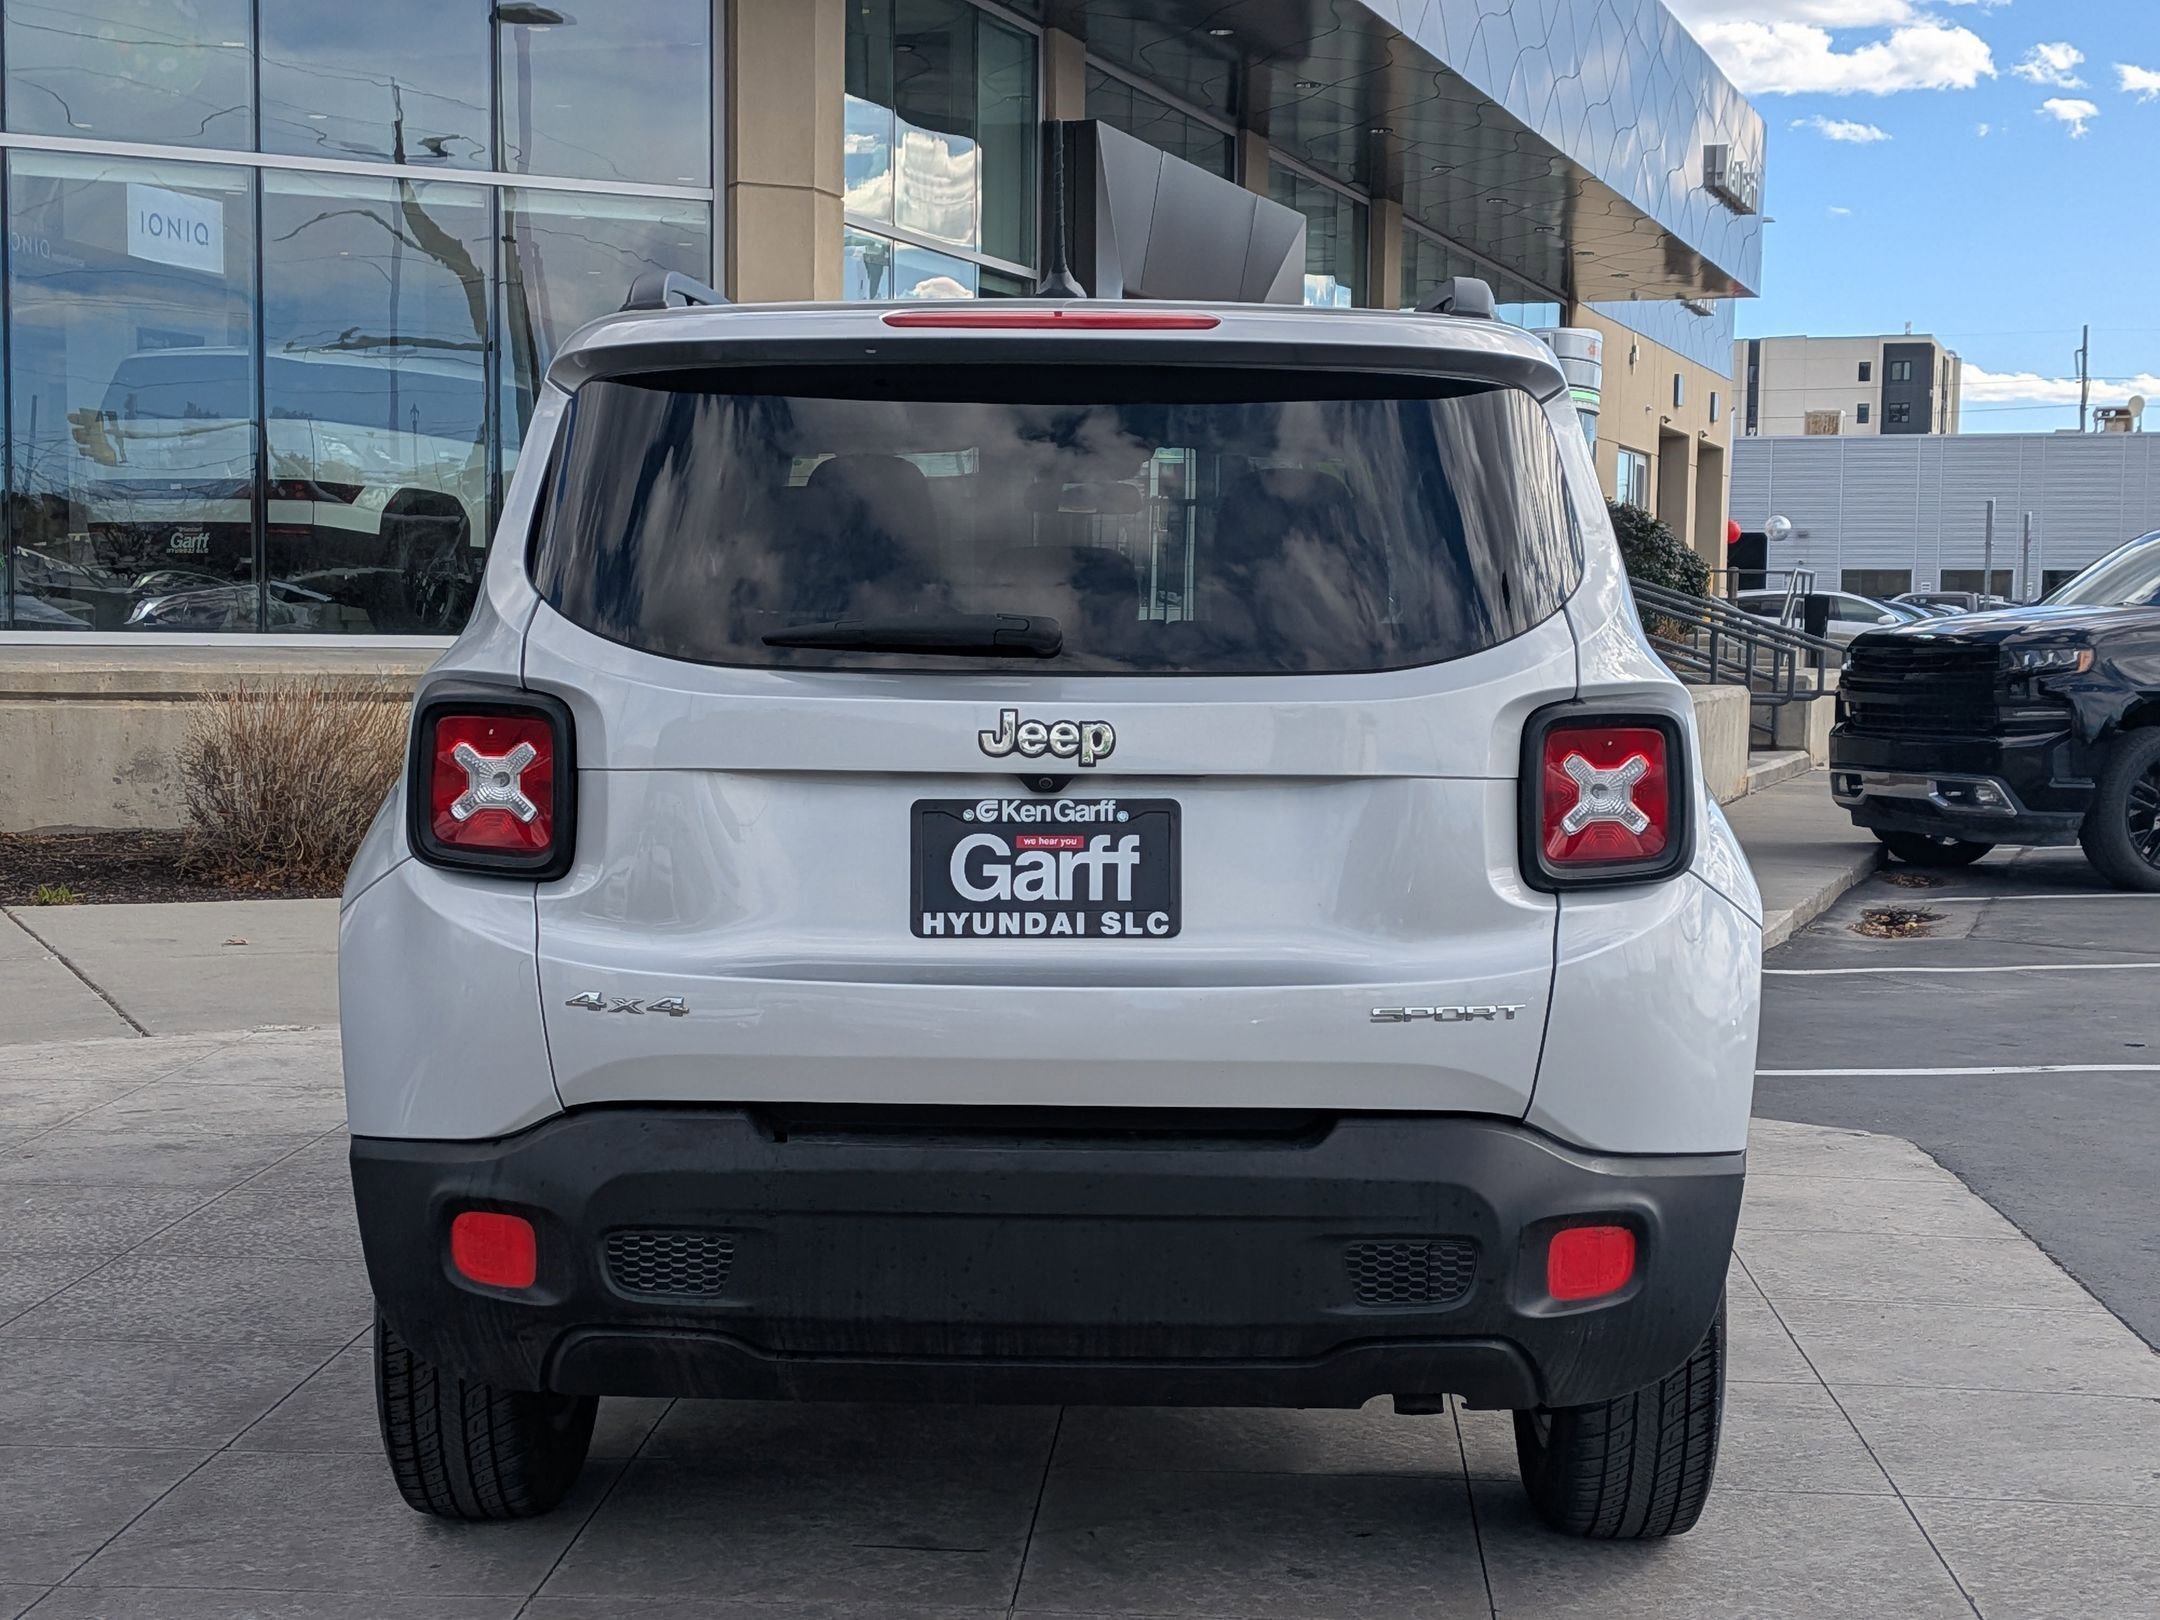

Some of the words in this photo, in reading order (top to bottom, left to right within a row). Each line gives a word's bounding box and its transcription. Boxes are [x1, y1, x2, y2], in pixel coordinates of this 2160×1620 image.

[140, 210, 209, 246] IONIQ
[11, 231, 50, 259] ONIQ
[170, 532, 210, 549] Garff
[978, 708, 1116, 767] Jeep
[1001, 799, 1051, 822] Ken
[1053, 799, 1116, 823] Garff
[1023, 837, 1037, 846] we
[1038, 836, 1059, 846] hear
[1060, 837, 1077, 848] you
[950, 832, 1140, 902] Garff
[922, 911, 1085, 935] HYUNDAI
[1100, 911, 1170, 935] SLC
[1370, 1003, 1527, 1023] SPORT
